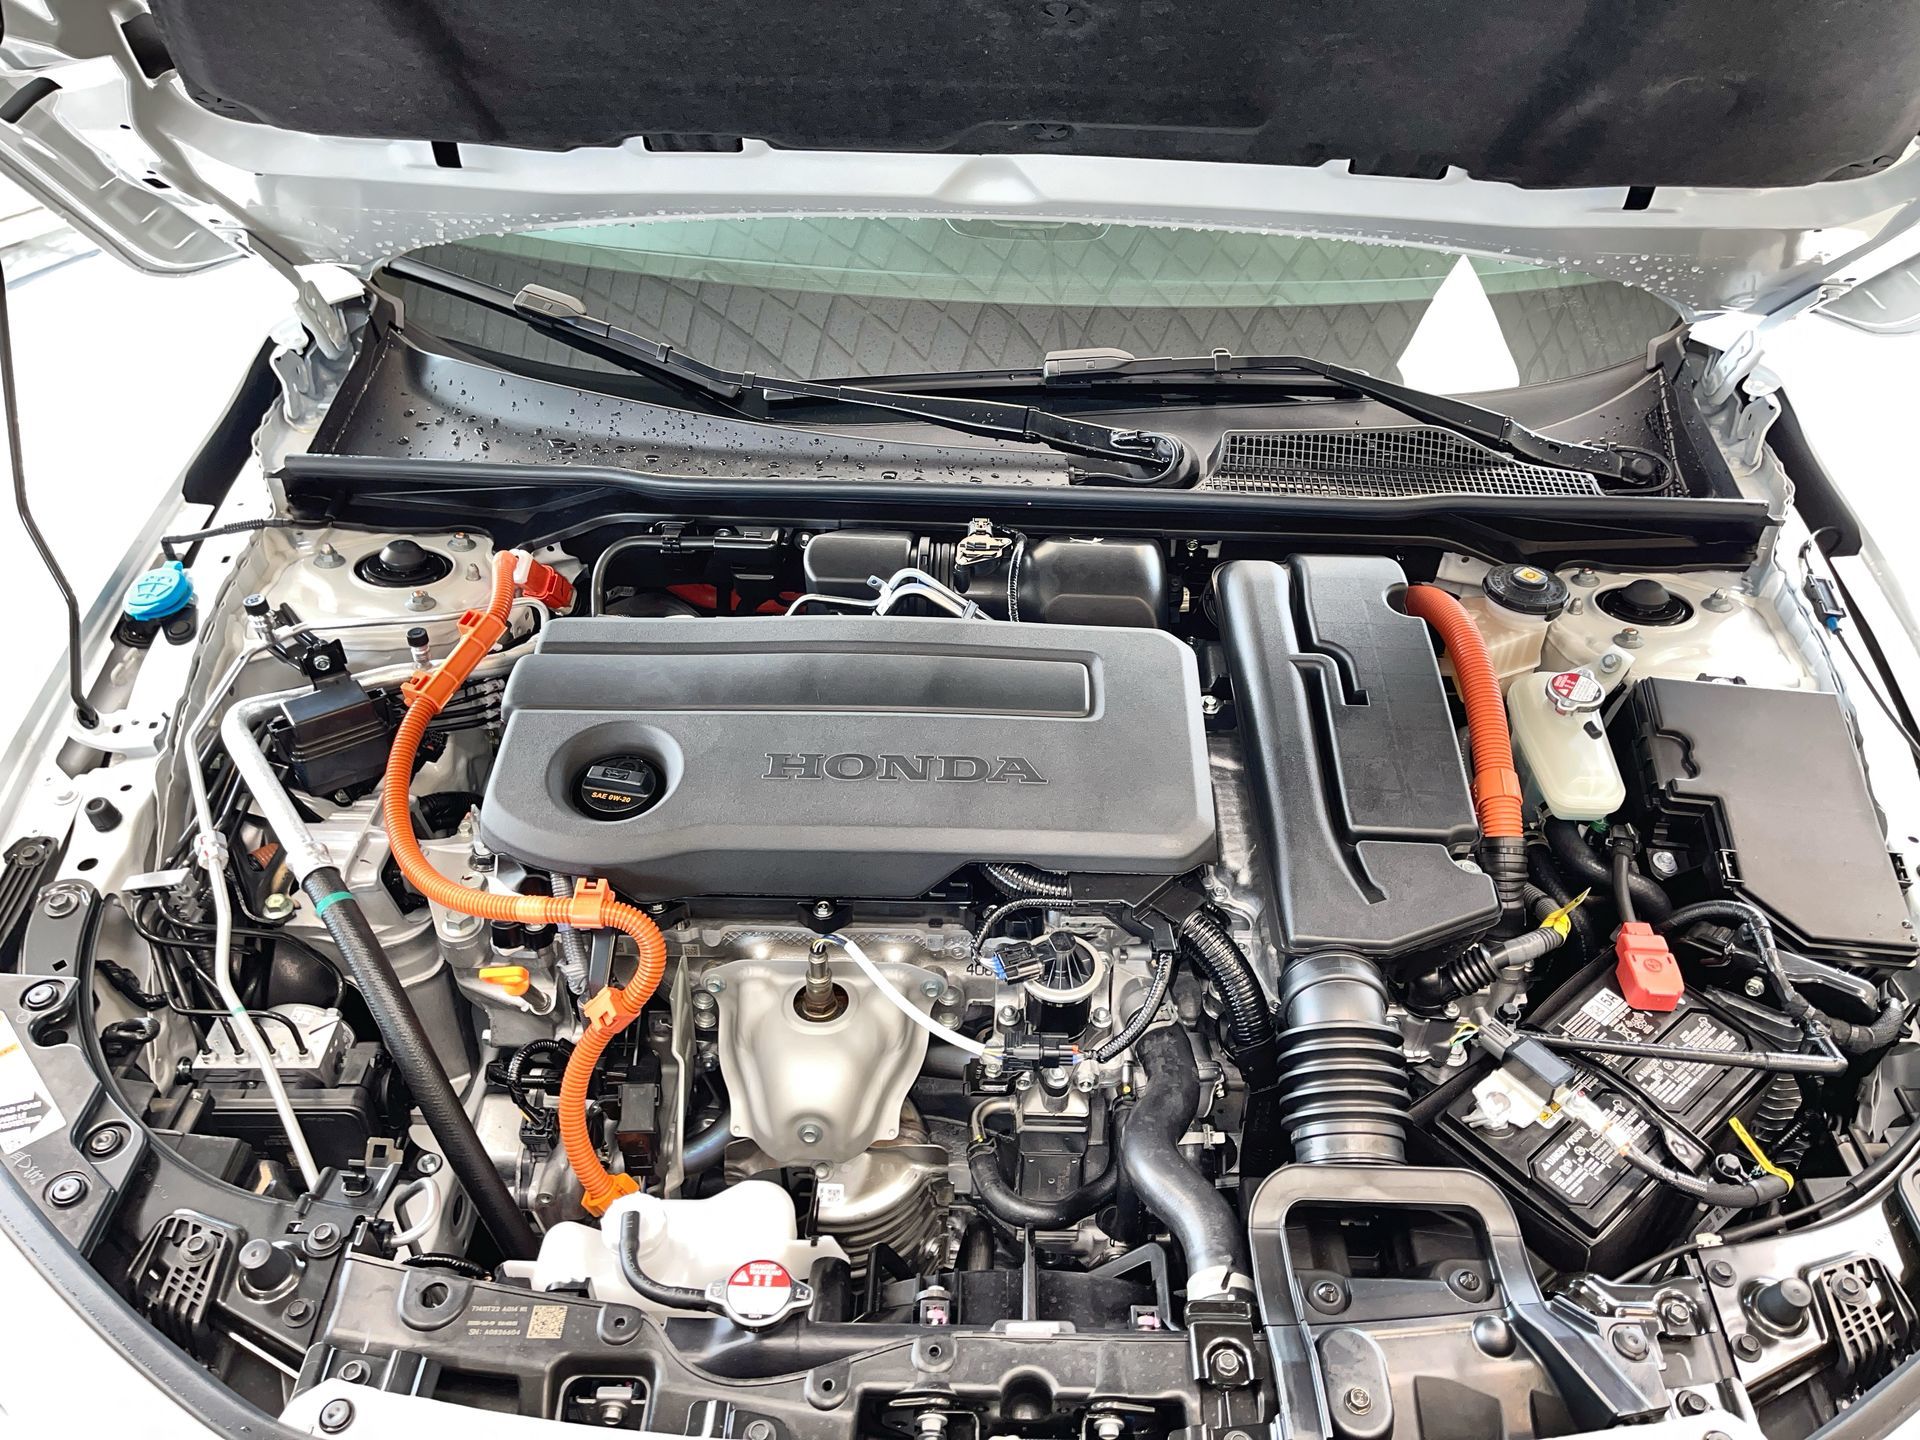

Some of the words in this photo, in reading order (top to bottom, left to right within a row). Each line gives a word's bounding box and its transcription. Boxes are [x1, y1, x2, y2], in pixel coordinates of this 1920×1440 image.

[761, 752, 1049, 785] HONDA
[591, 791, 607, 800] SAE
[608, 794, 631, 803] 0W-20
